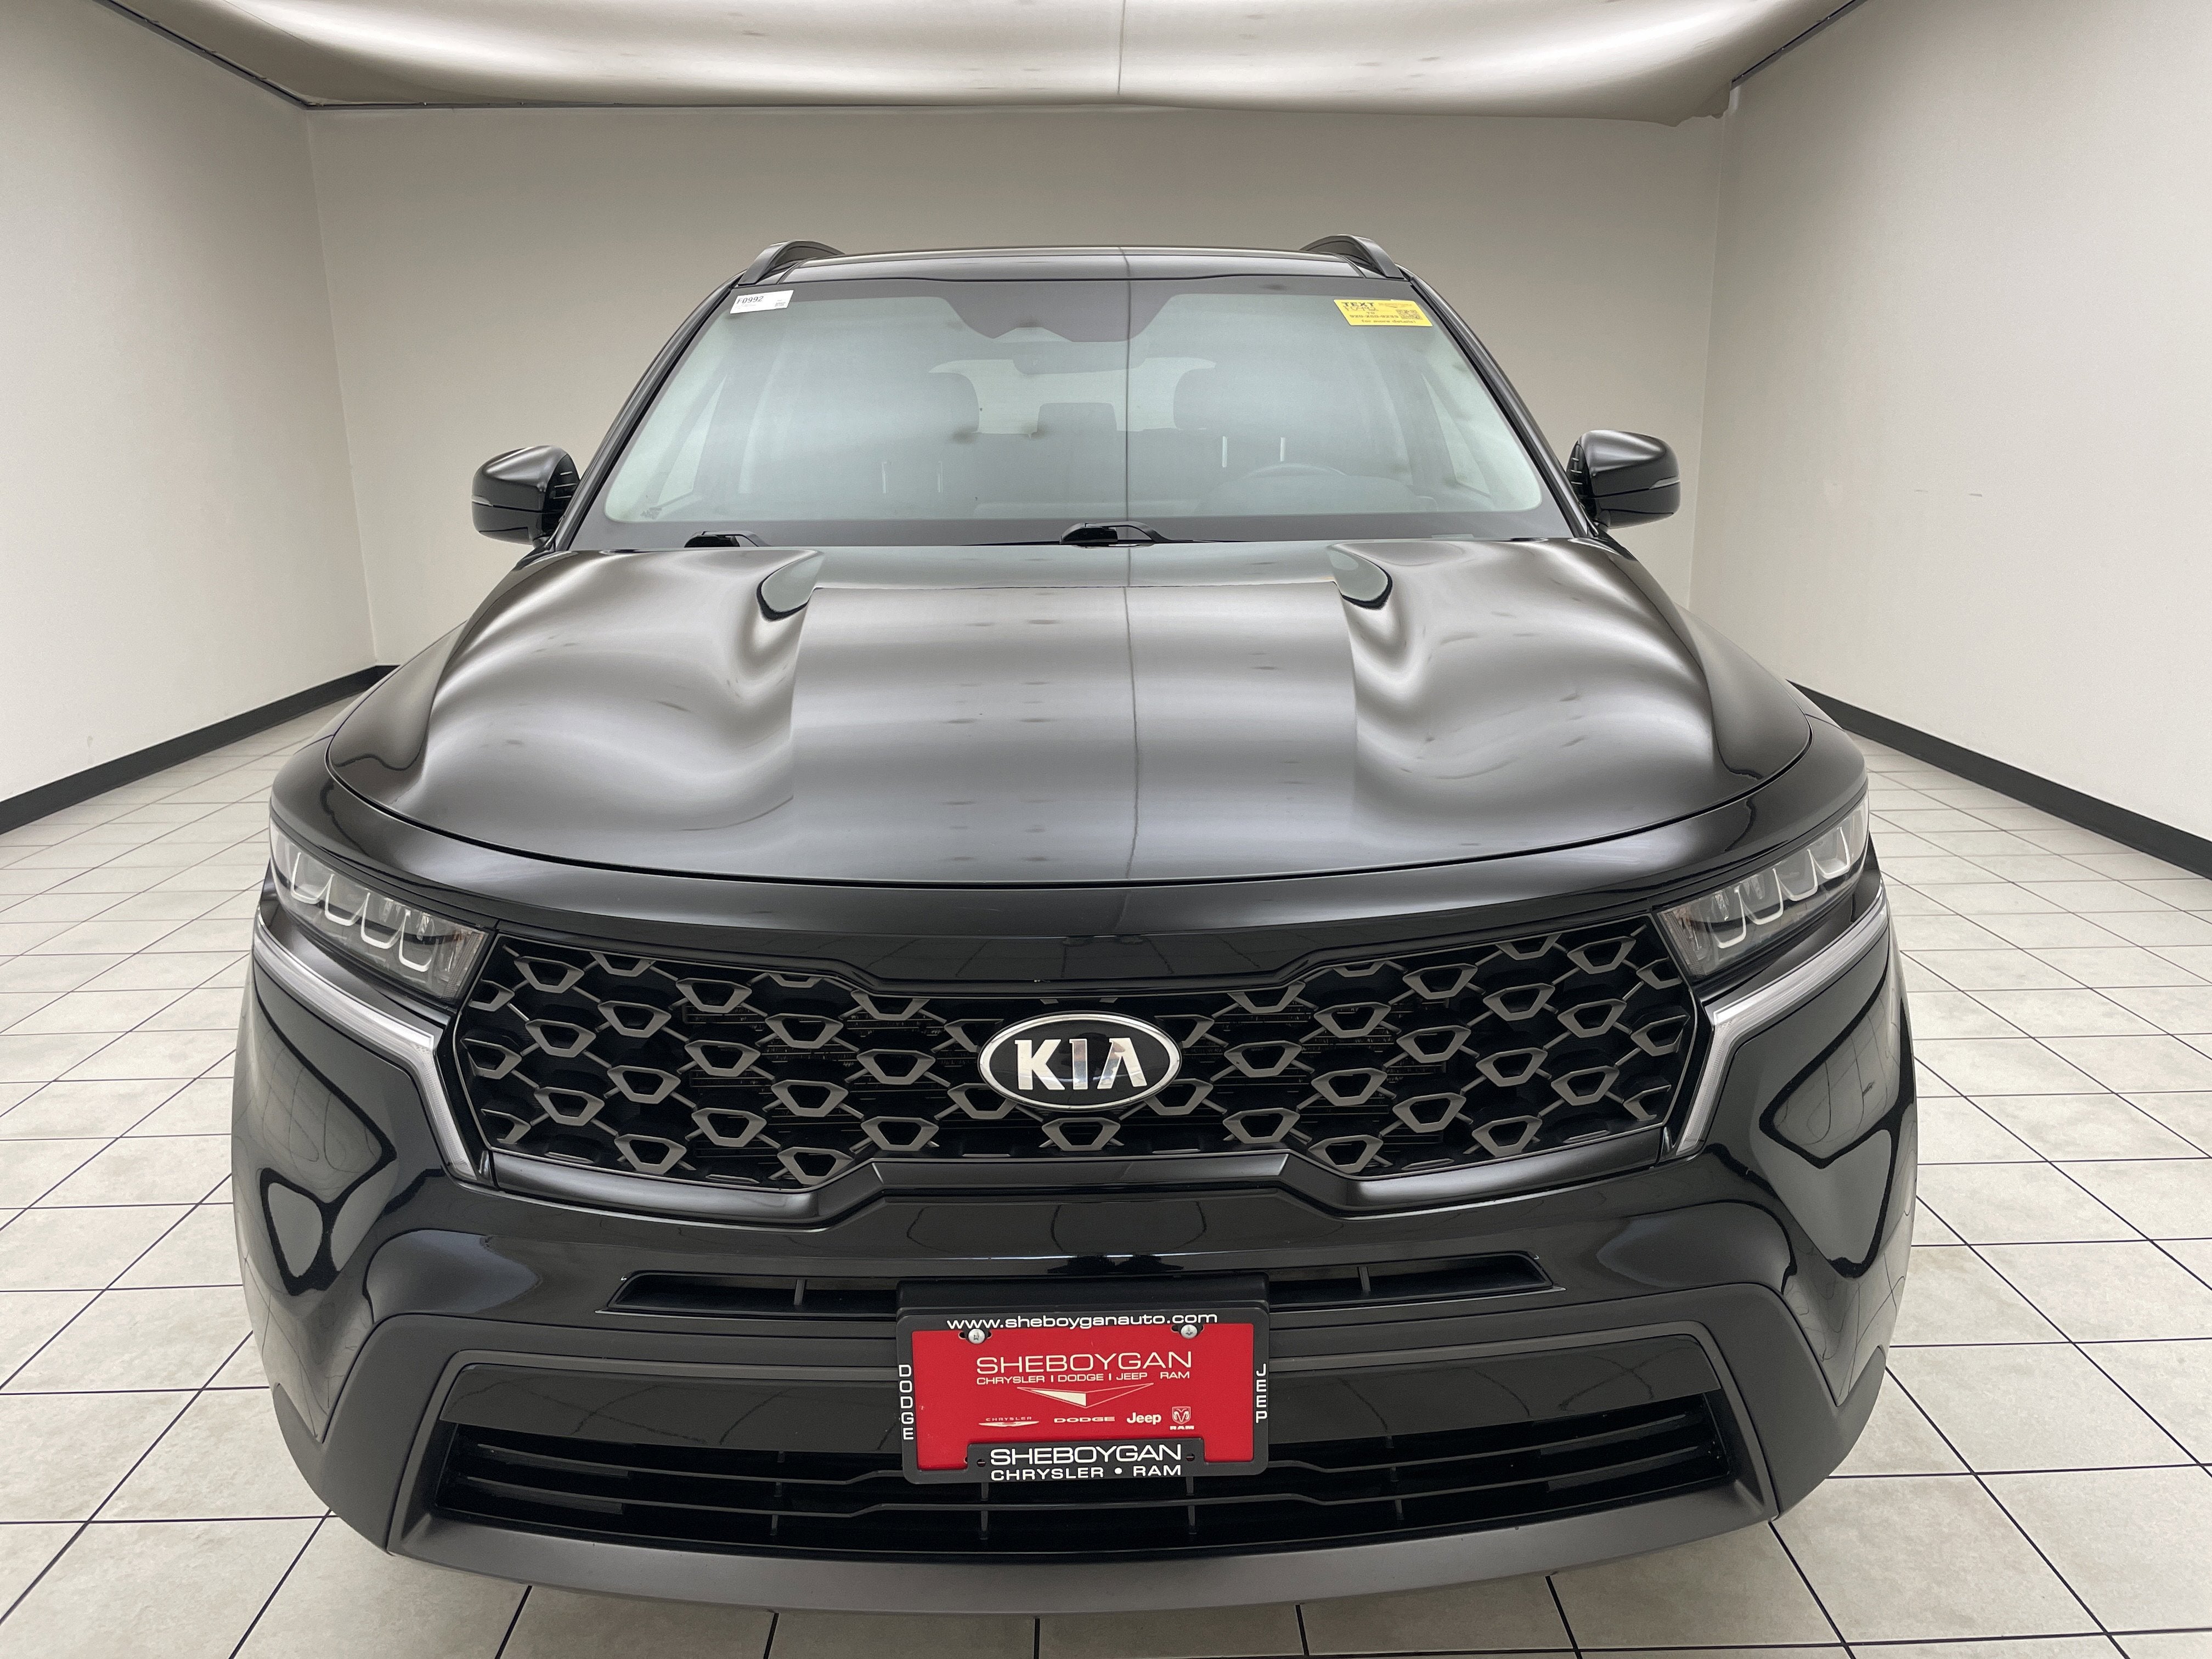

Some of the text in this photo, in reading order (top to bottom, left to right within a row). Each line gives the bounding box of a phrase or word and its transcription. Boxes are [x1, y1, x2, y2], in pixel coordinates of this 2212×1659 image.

[736, 296, 764, 304] F0992
[1014, 1037, 1148, 1091] KIA
[946, 1312, 1217, 1330] www.sheboyganauto.com
[976, 1351, 1192, 1375] SHEBOYGAN
[976, 1371, 1190, 1385] CHRYSLER DODGE JEEP RAM
[899, 1364, 914, 1441] DODGE
[1255, 1364, 1267, 1424] JEEP
[1126, 1412, 1162, 1425] Jeep
[990, 1443, 1182, 1466] SHEBOYGAN
[990, 1464, 1181, 1481] CHRYSLER RAM
